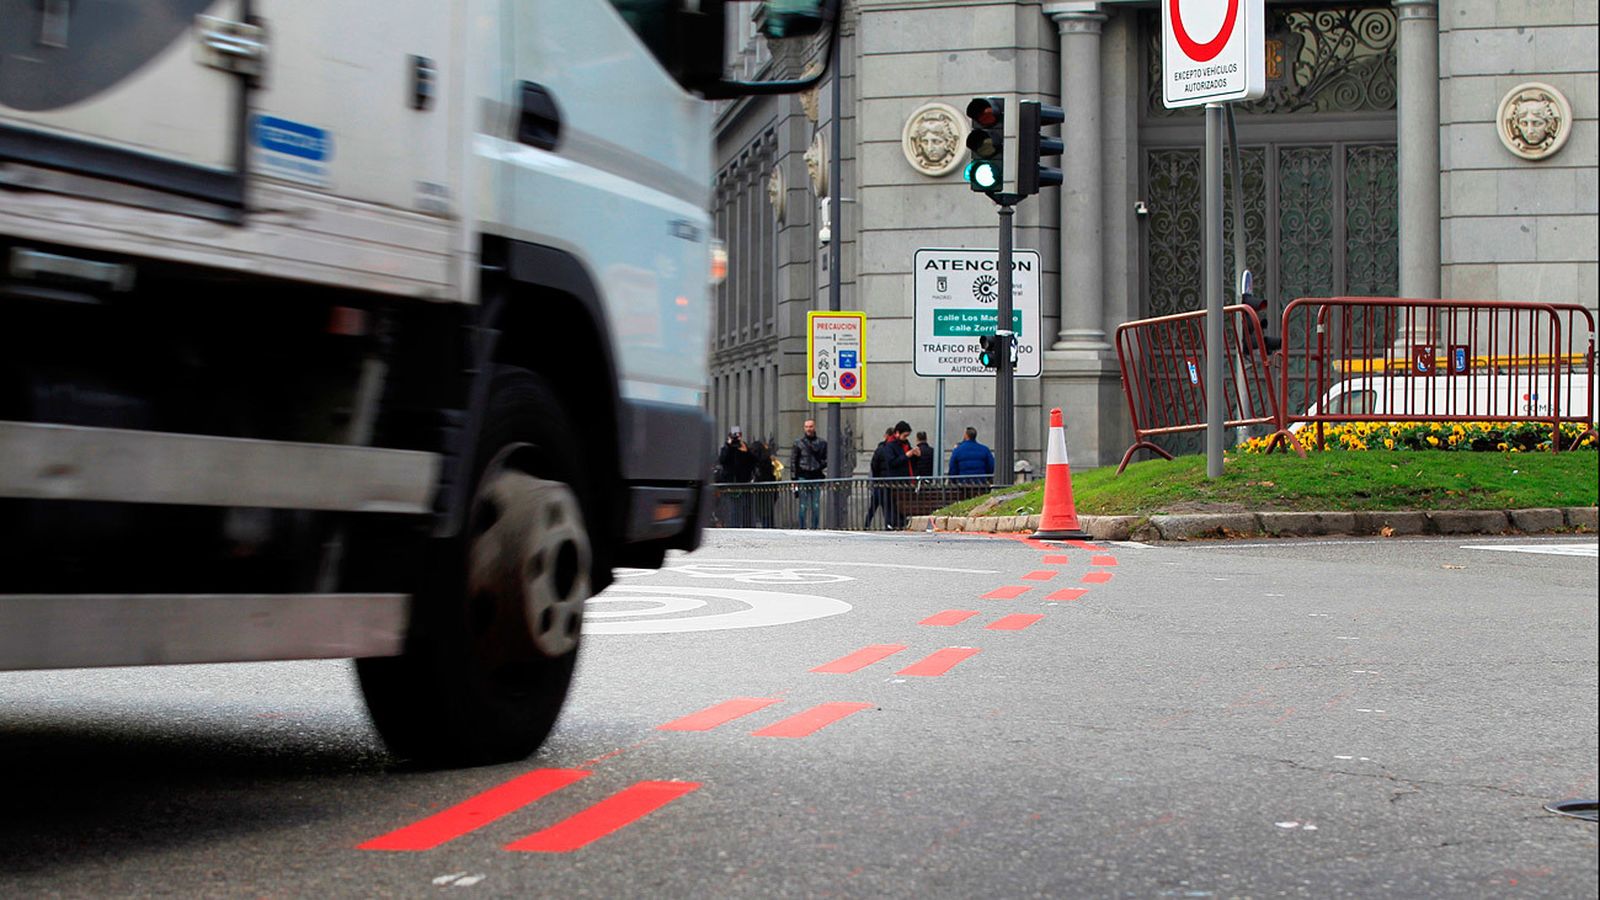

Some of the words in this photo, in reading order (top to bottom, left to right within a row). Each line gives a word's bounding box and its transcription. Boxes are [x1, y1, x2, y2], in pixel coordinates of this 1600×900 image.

[1174, 69, 1202, 81] EXCEPTO
[1203, 63, 1237, 76] VEHÍCULOS
[1184, 78, 1227, 92] AUTORIZADOS
[937, 314, 959, 322] calle
[962, 314, 978, 322] Los
[949, 324, 971, 332] calle
[923, 343, 965, 354] TRÁFICO
[938, 356, 973, 364] EXCEPTO
